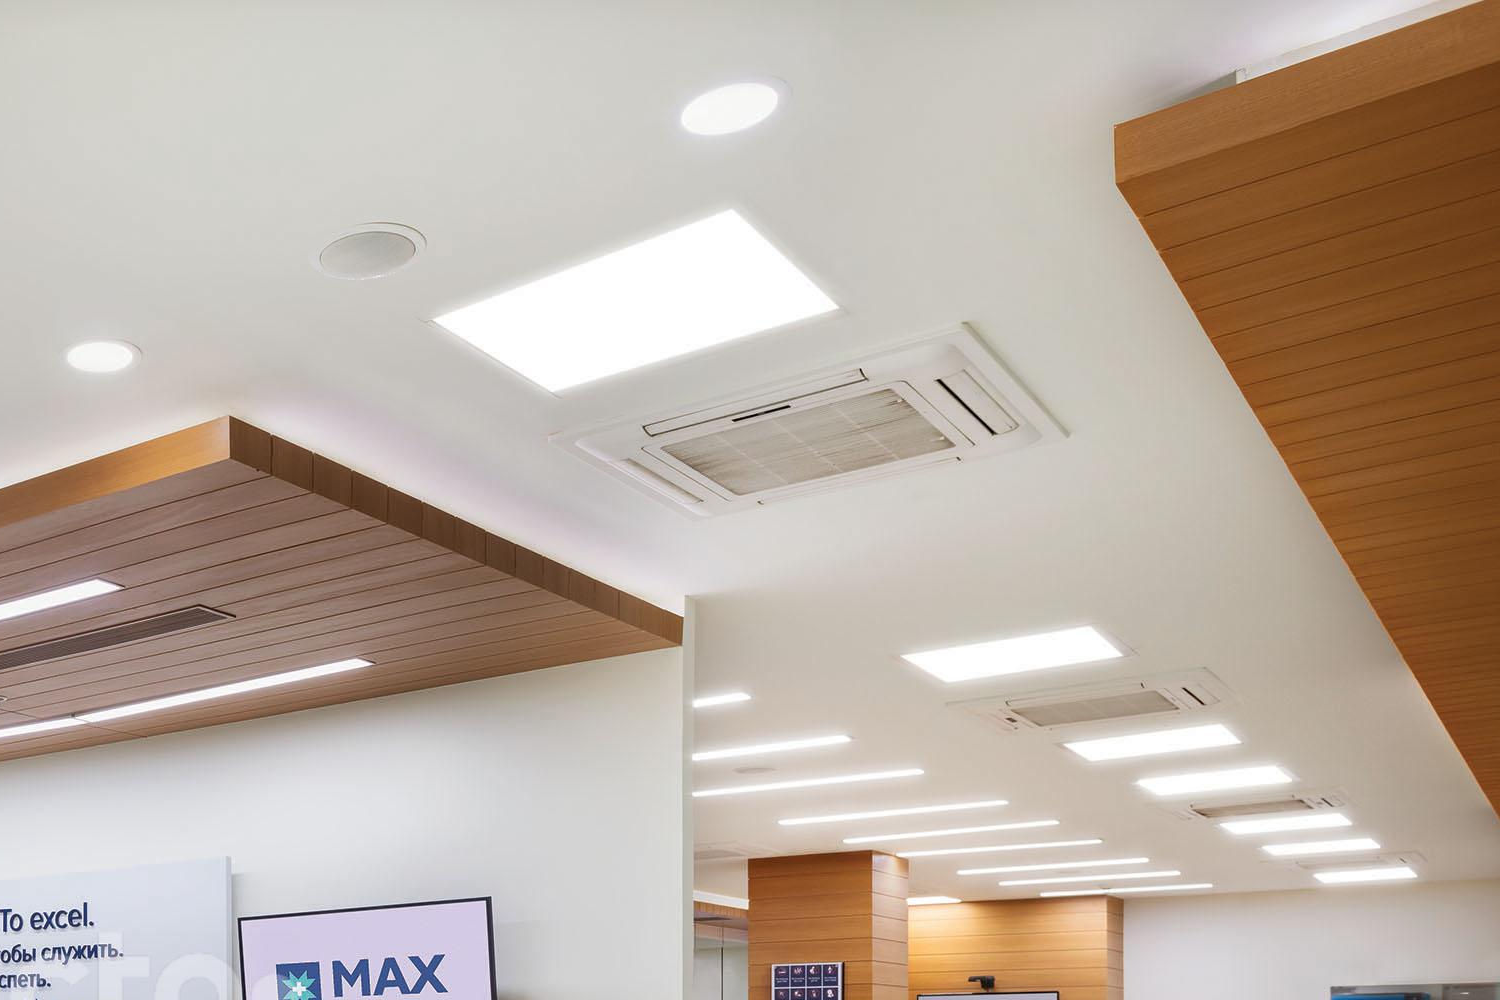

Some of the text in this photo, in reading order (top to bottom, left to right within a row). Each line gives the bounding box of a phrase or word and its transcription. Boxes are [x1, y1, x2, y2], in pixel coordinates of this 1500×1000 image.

[29, 902, 94, 930] excel.
[41, 943, 124, 965] служить.
[332, 954, 448, 998] MAX
